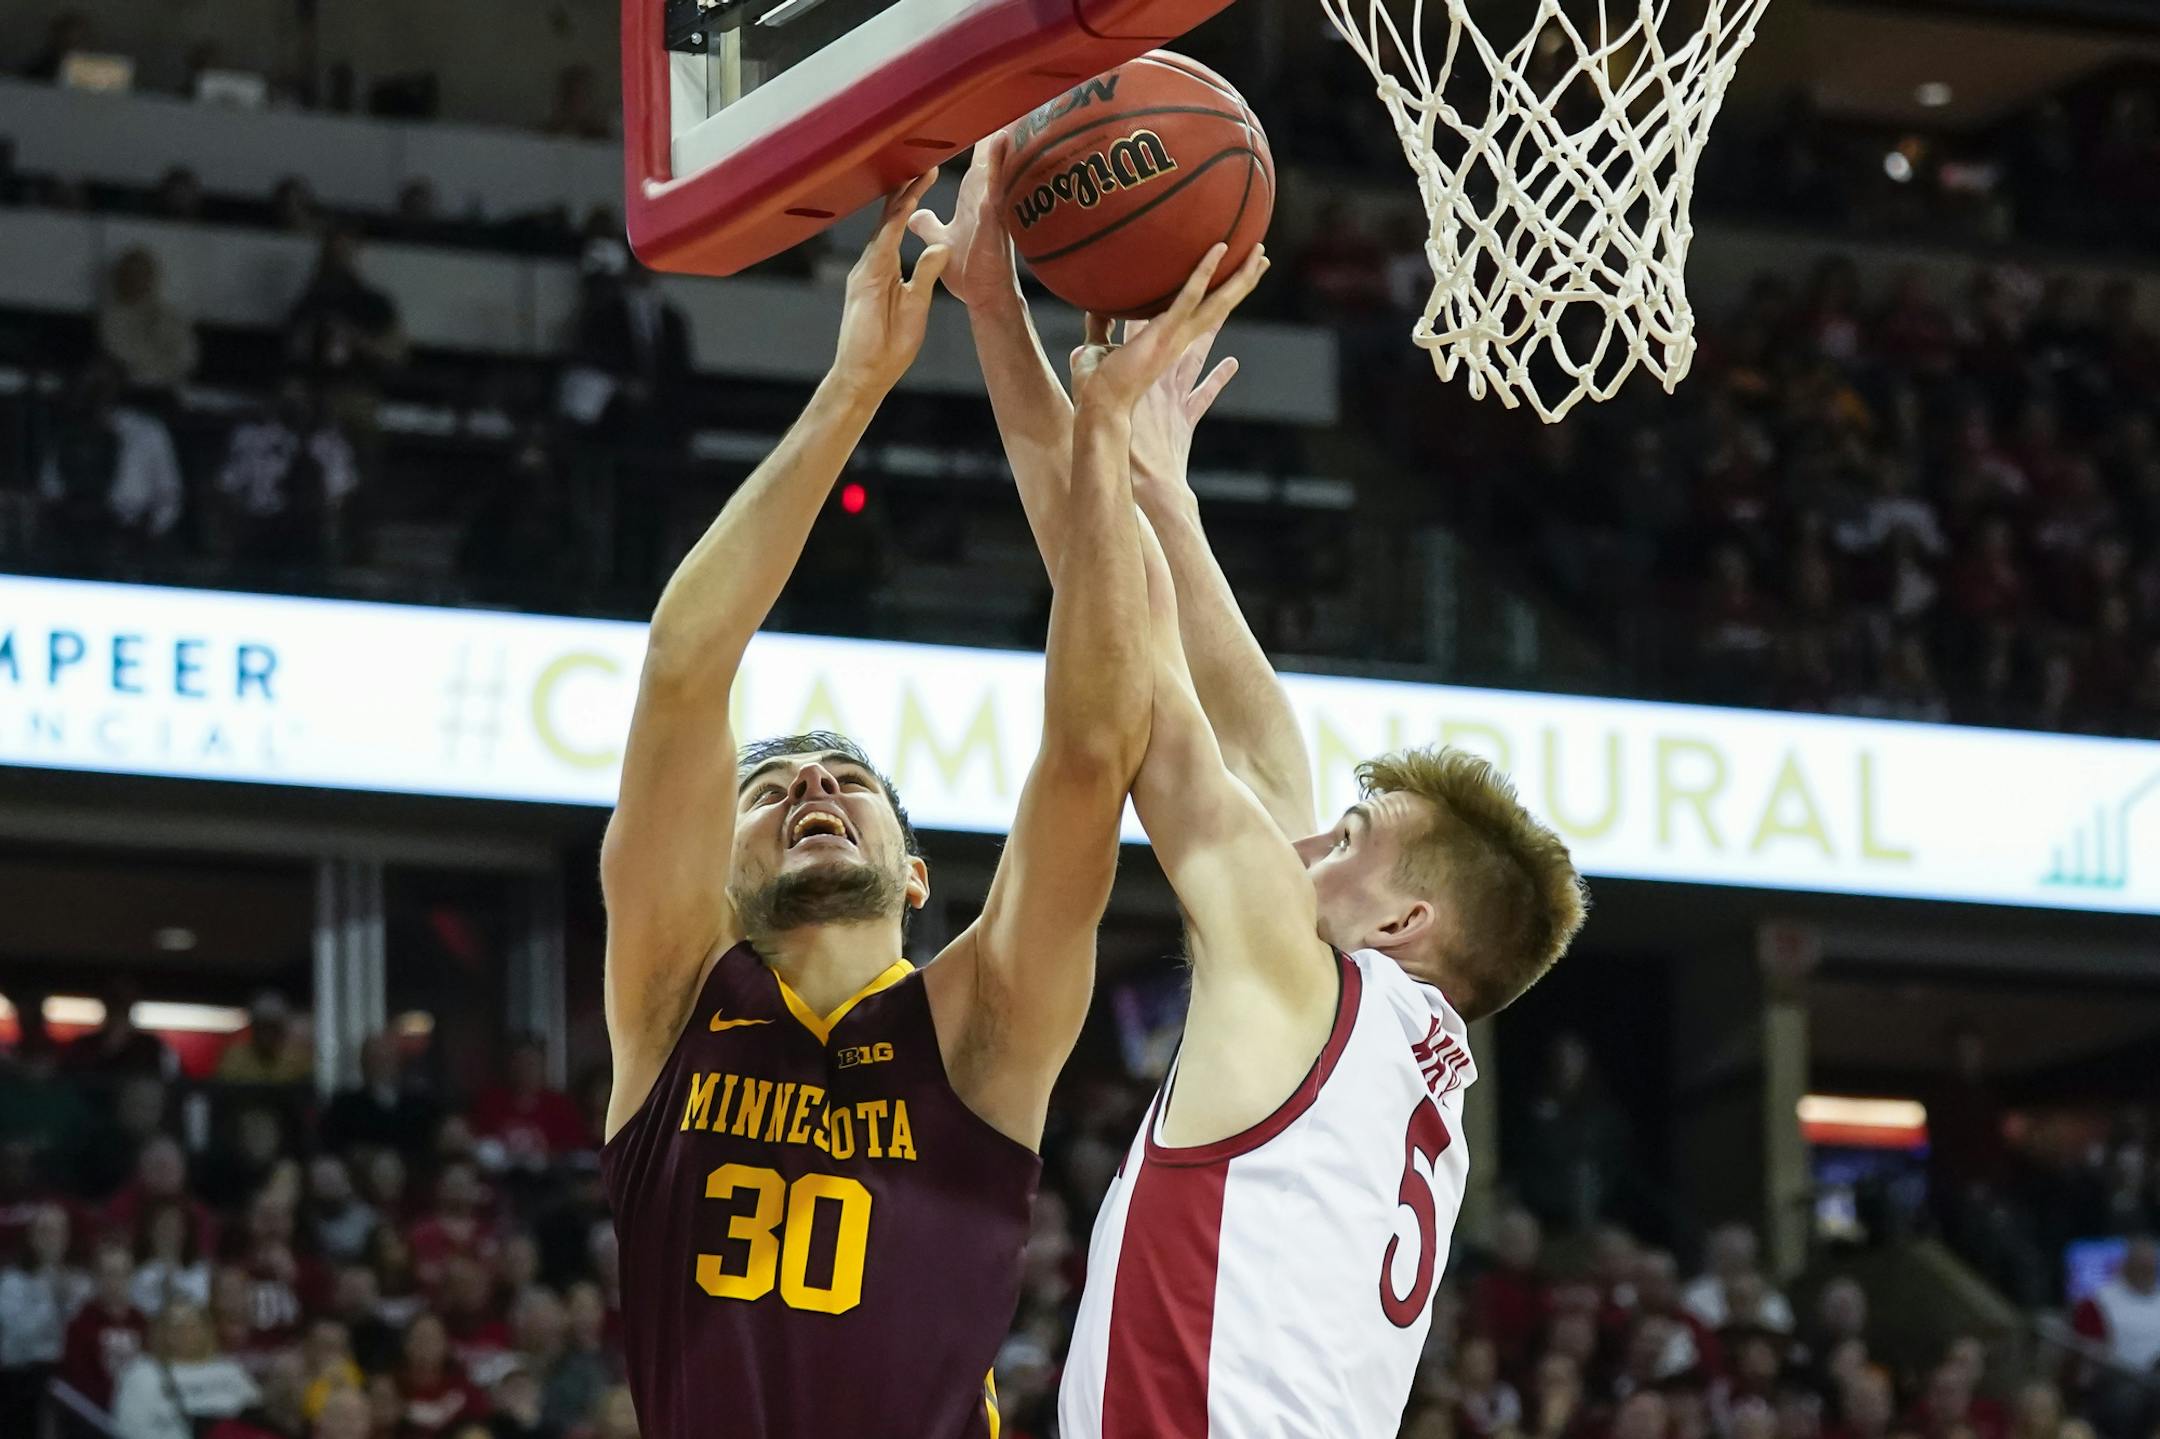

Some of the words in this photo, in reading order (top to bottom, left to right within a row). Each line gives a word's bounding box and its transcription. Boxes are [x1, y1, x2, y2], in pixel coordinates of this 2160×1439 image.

[1013, 129, 1179, 230] Wilson
[679, 1072, 918, 1161] MINNESOTA
[695, 1162, 873, 1316] 30
[1379, 1094, 1452, 1330] 5
